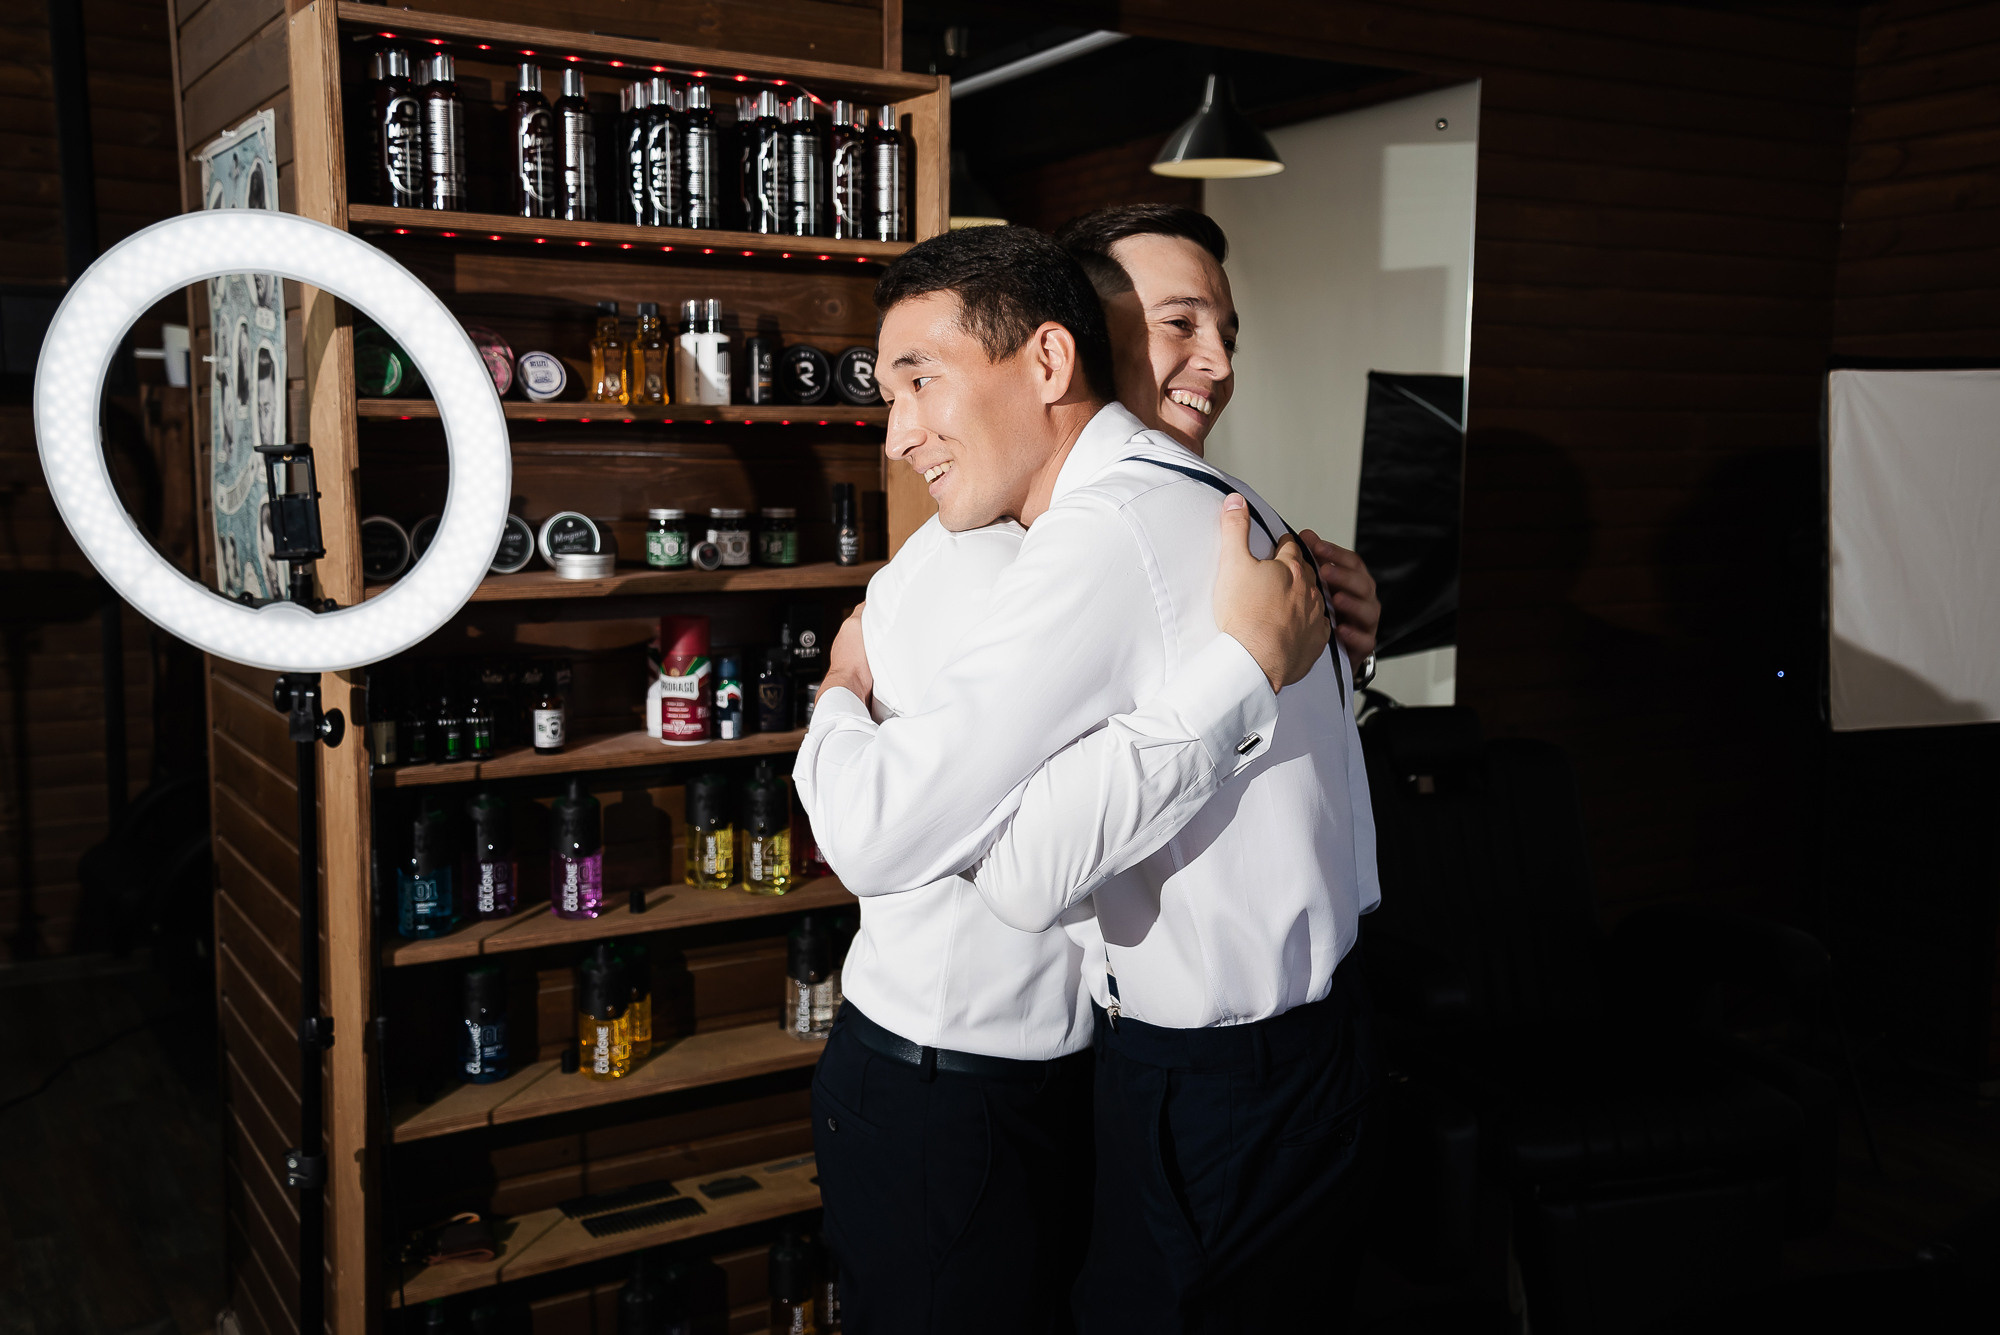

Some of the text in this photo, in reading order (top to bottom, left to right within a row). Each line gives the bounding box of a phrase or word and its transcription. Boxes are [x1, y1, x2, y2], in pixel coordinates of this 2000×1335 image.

[796, 361, 815, 387] R
[853, 360, 873, 388] R
[481, 862, 495, 912] COLOGNE
[565, 863, 579, 912] COLOGNE
[798, 988, 810, 1033] COLOGNE
[596, 1026, 610, 1074] COLOGNE
